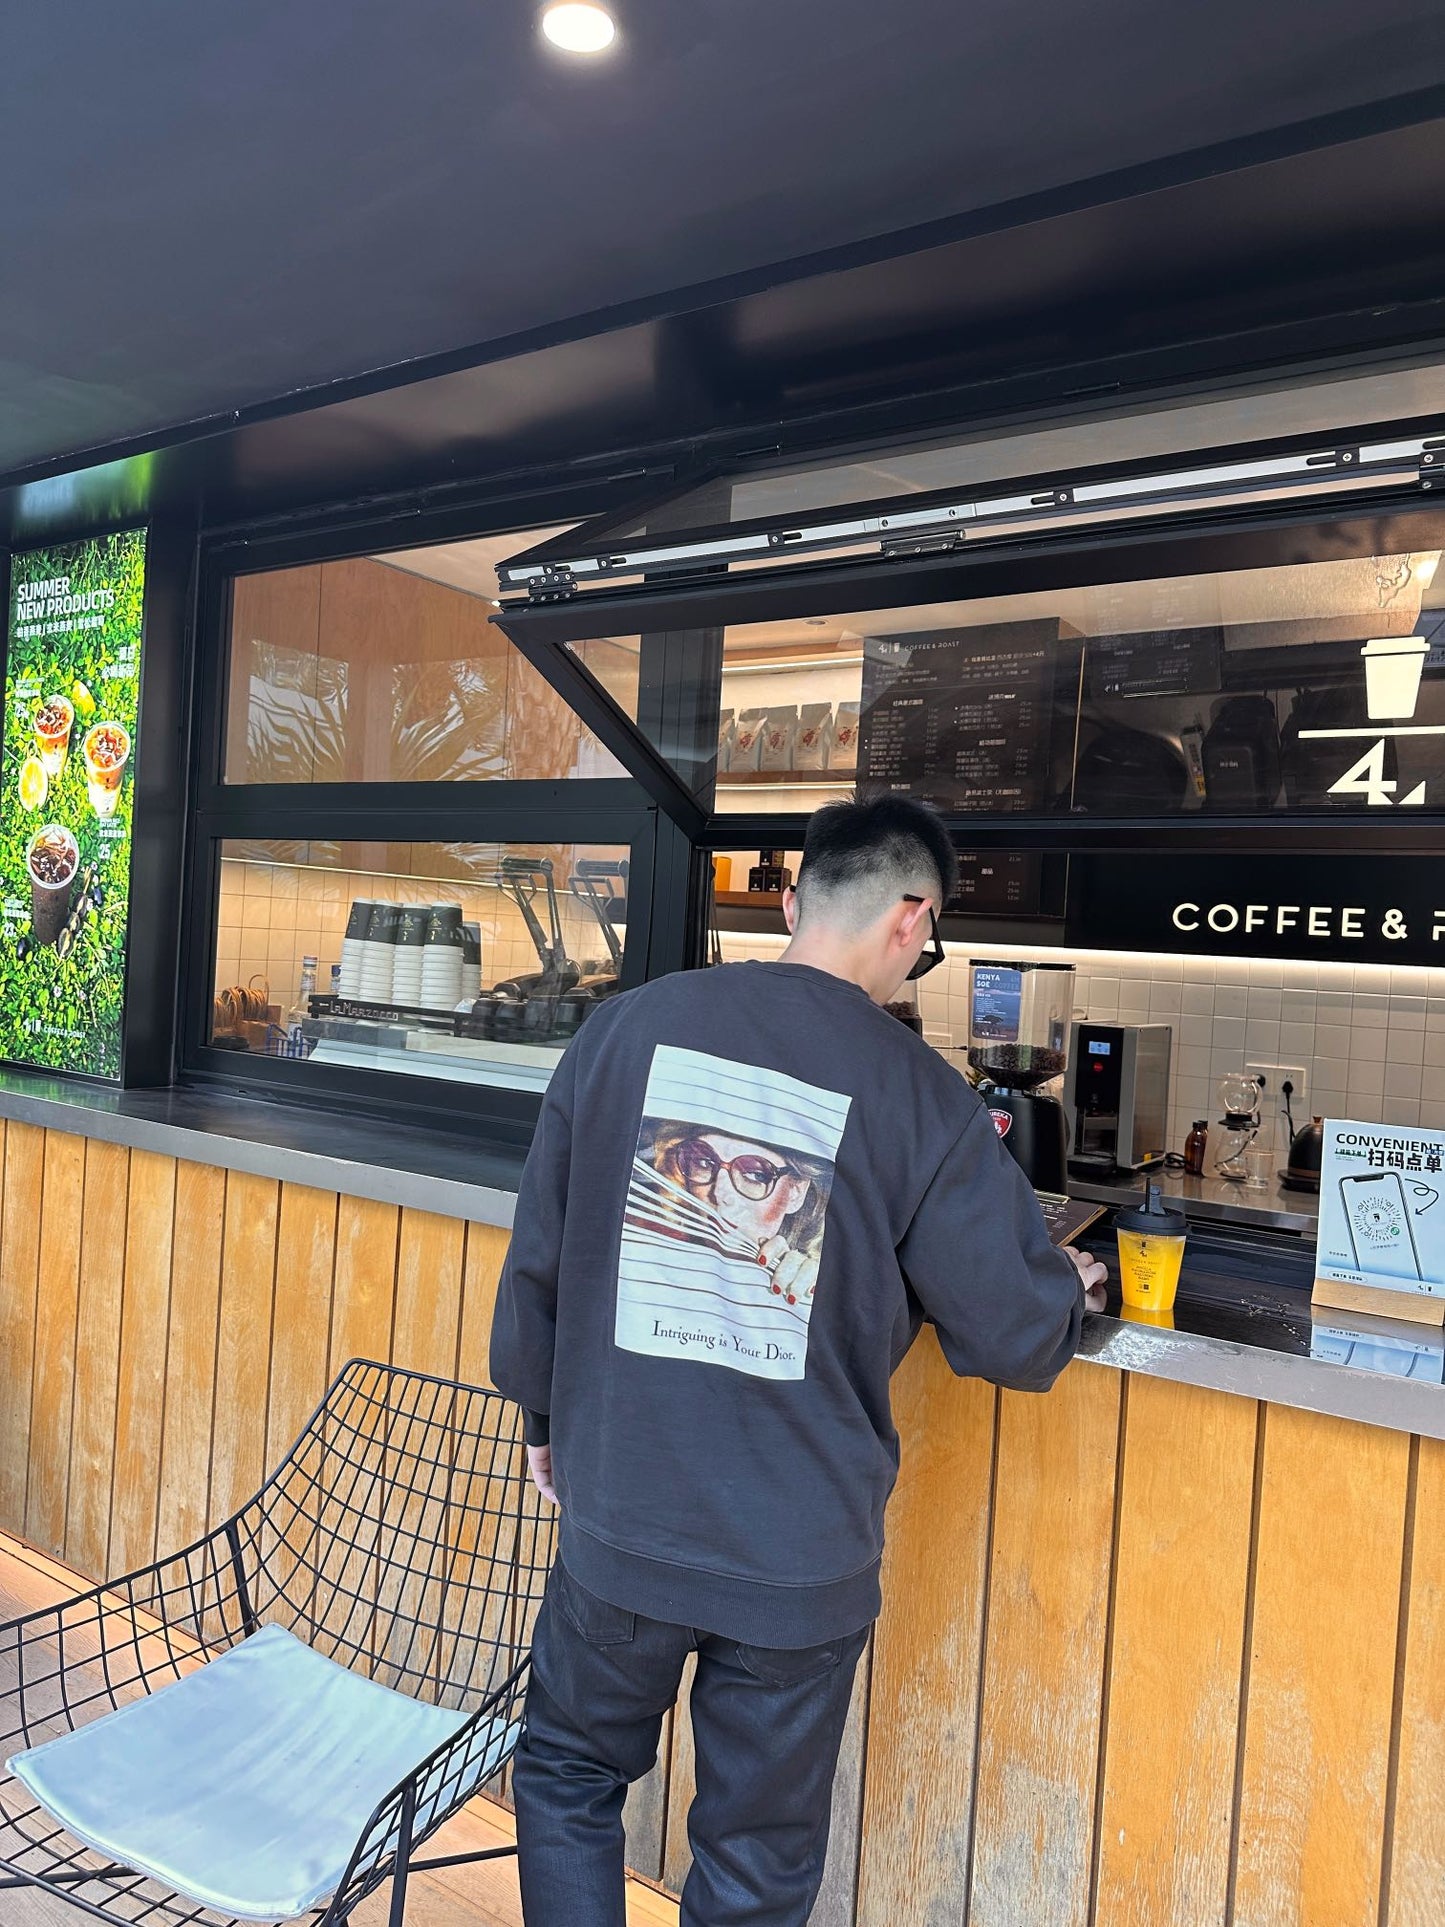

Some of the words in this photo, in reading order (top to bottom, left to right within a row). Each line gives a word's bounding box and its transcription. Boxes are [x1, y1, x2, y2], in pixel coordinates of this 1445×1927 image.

[17, 576, 70, 602] SUMMER
[16, 600, 45, 620] NEW
[47, 588, 115, 618] PRODUCTS
[1172, 902, 1366, 938] COFFEE
[1381, 908, 1408, 940] &
[976, 973, 1001, 982] KENYA
[989, 1110, 1008, 1120] UREKA
[1336, 1133, 1443, 1153] CONVENIENT
[1368, 1148, 1443, 1173] 扫码点单
[651, 1320, 717, 1350] Intriguing
[719, 1333, 728, 1347] is
[731, 1334, 761, 1359] Your
[763, 1343, 796, 1361] Dior.
